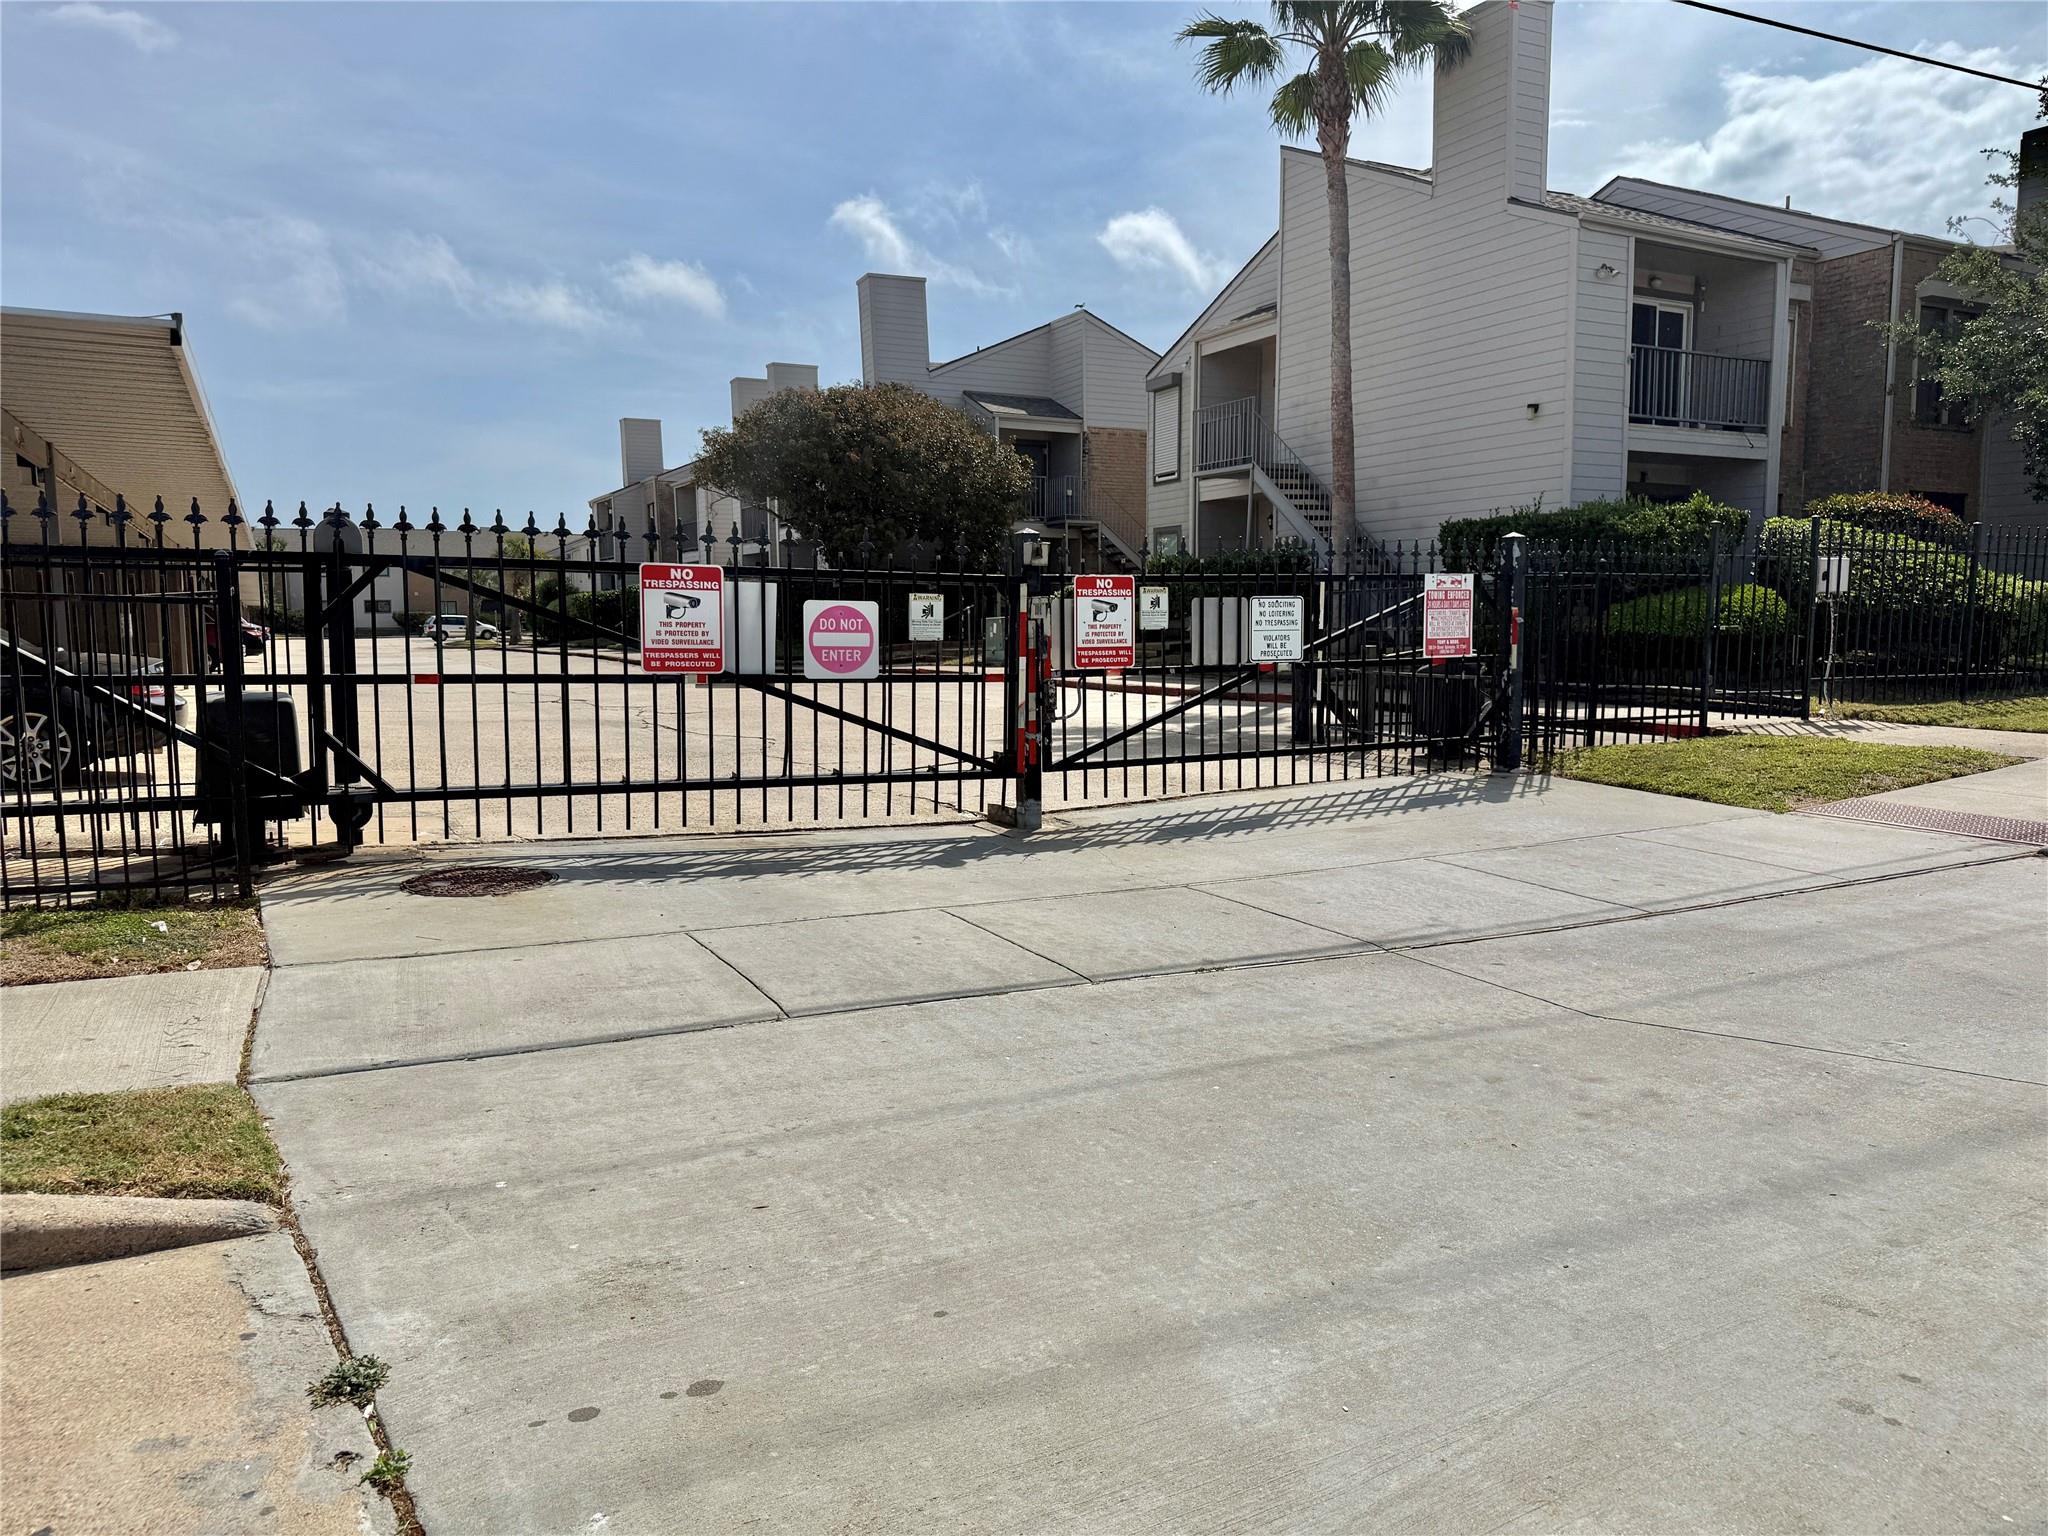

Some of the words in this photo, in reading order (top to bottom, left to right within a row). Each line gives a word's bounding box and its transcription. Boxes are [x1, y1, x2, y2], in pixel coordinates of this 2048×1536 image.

[670, 568, 694, 580] NO
[644, 580, 719, 589] TRESPASSING
[1096, 579, 1113, 588] NO
[1428, 591, 1445, 600] TOWING
[1447, 591, 1469, 599] ENFORCED
[820, 618, 836, 630] DO
[840, 619, 863, 631] NOT
[822, 650, 861, 662] ENTER
